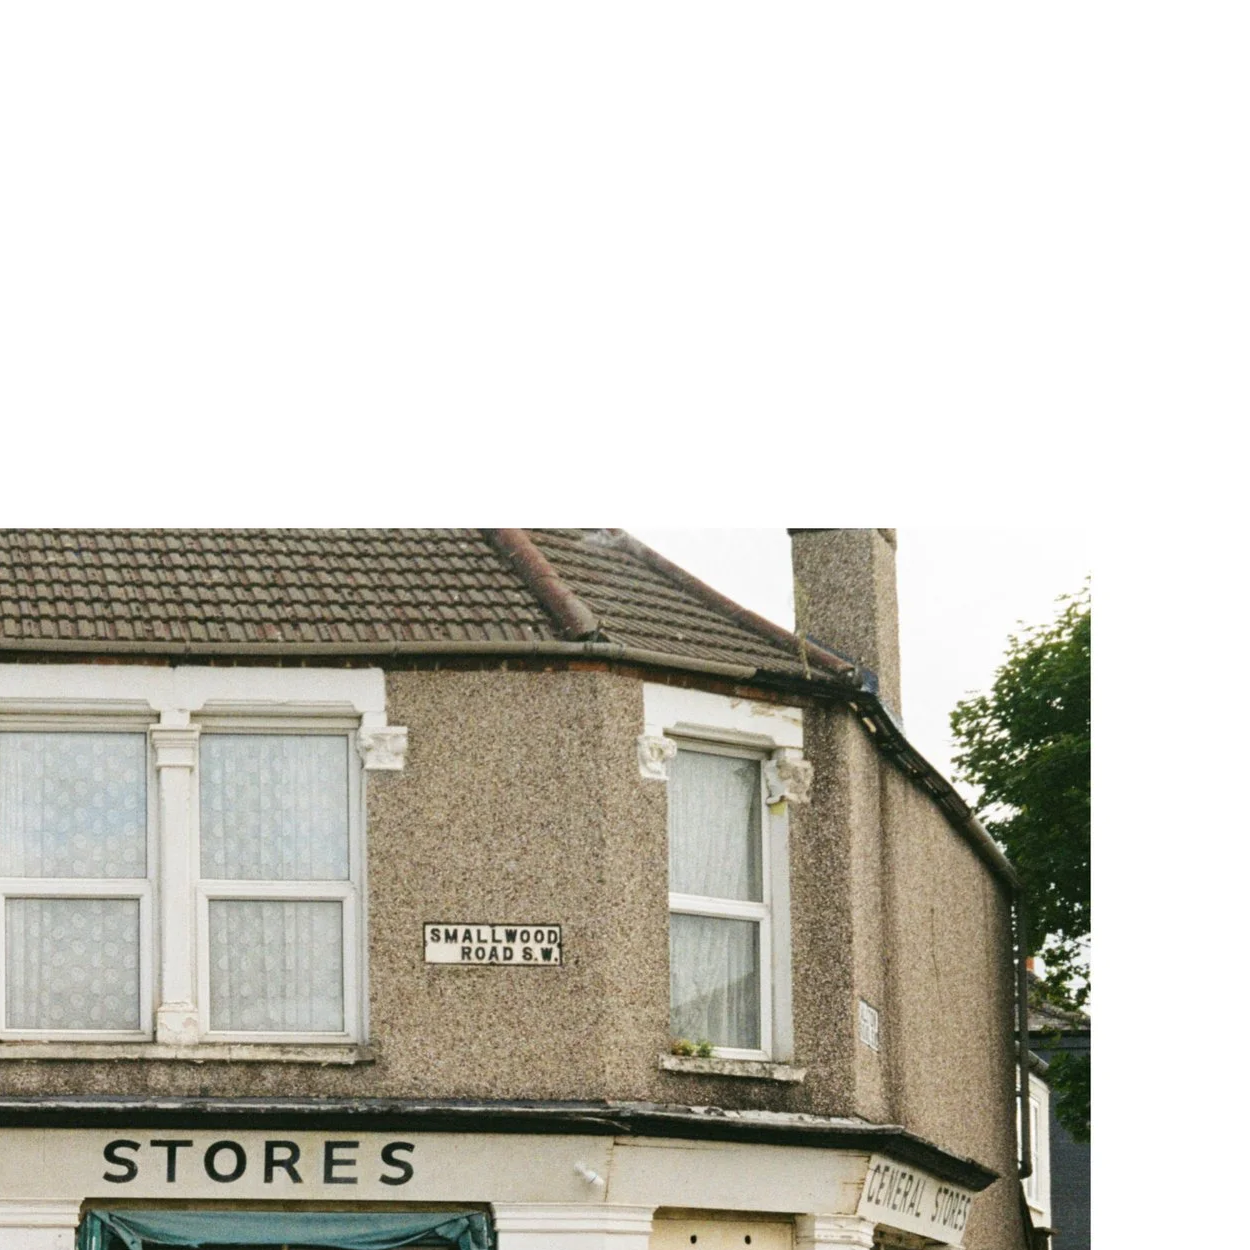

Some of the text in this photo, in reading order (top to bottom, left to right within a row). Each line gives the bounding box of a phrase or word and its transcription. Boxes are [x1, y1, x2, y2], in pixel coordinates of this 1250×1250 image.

[430, 928, 558, 944] SMALLWOOD
[461, 946, 558, 962] ROAD S.W.
[102, 1139, 416, 1186] STORES
[867, 1164, 971, 1232] GENERAL STORES
